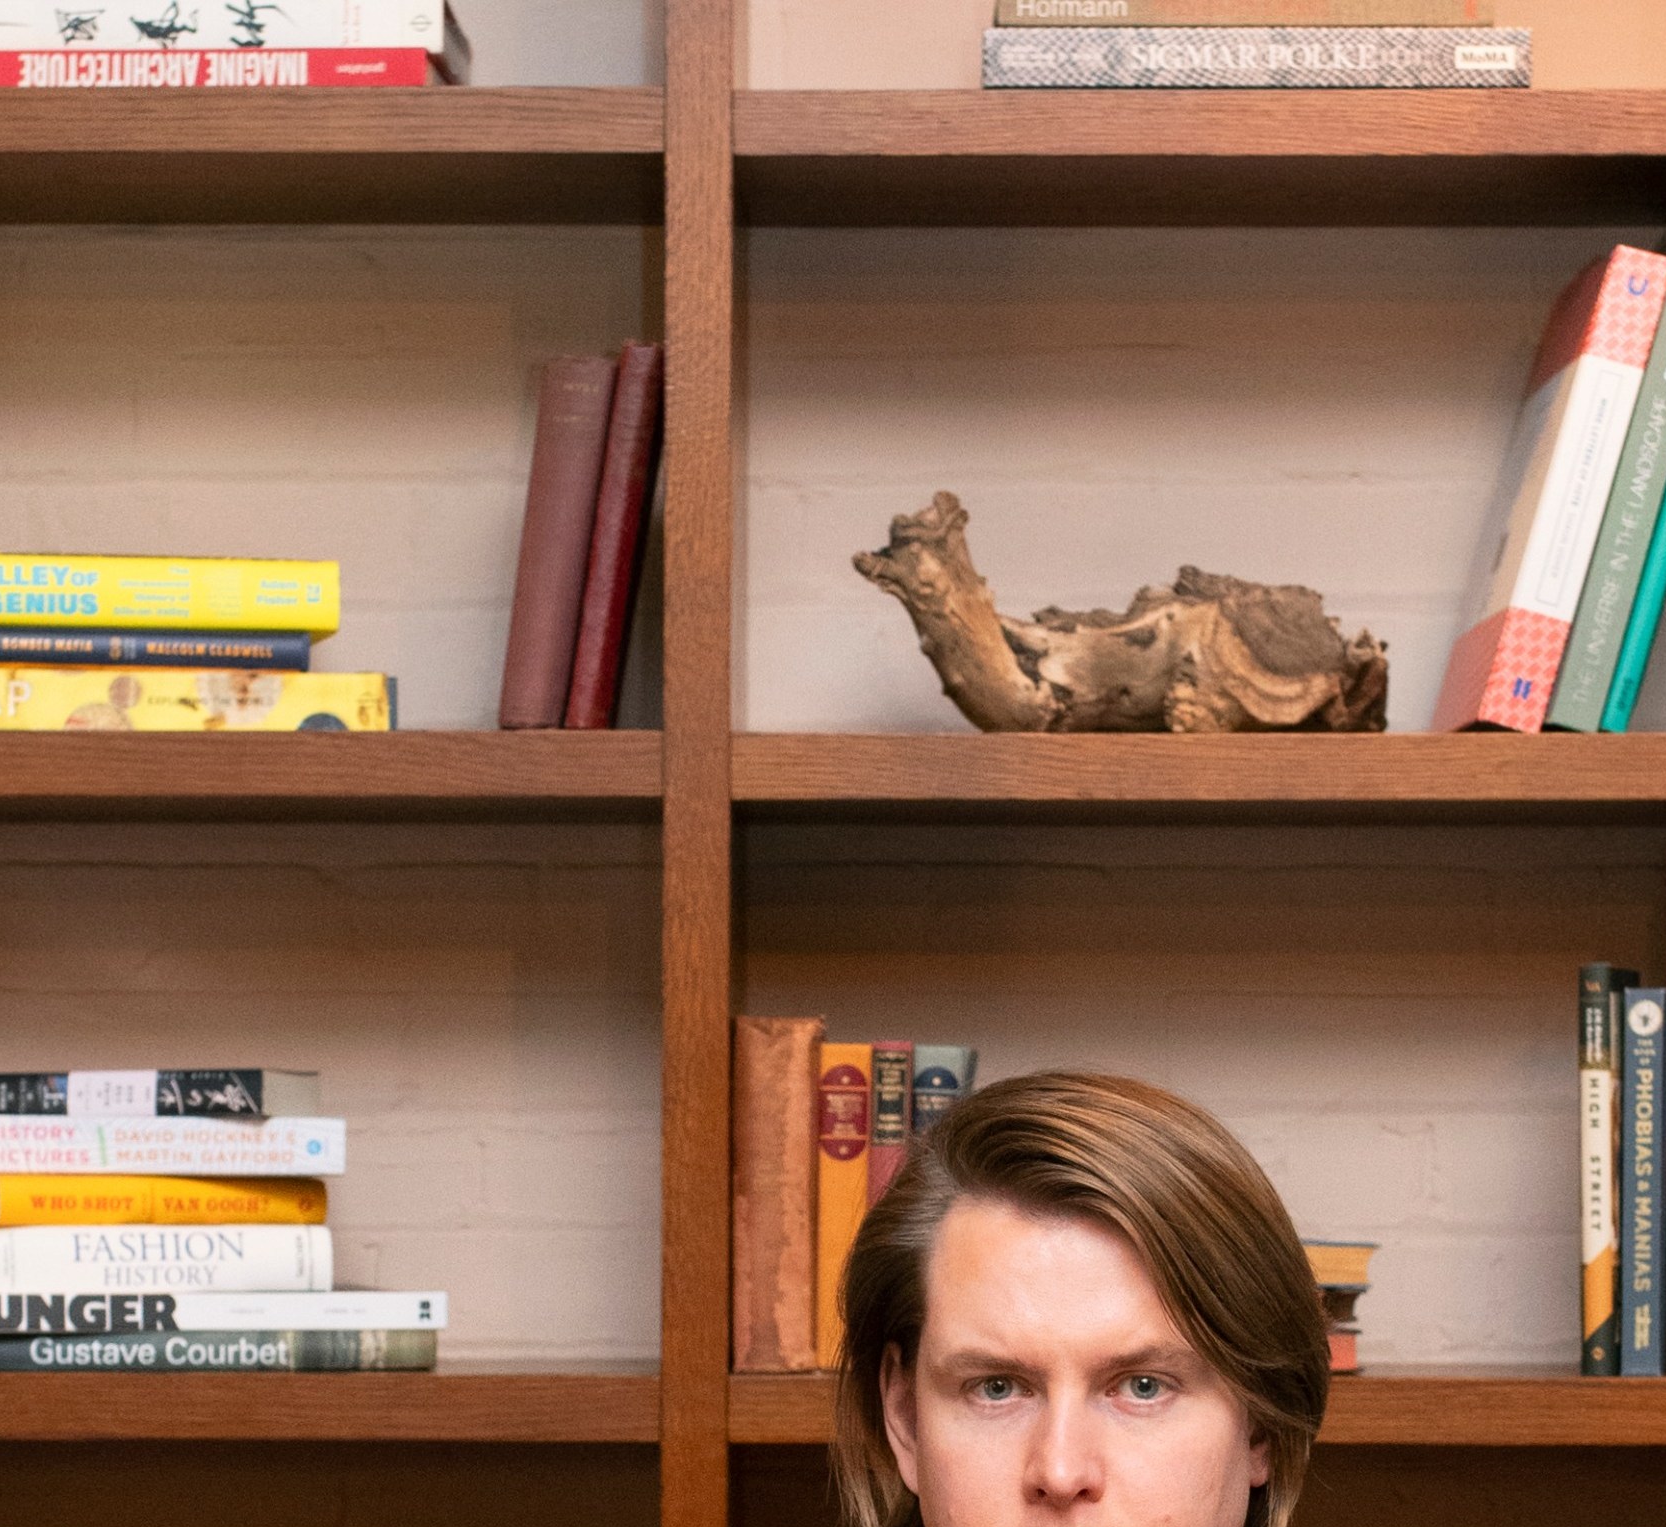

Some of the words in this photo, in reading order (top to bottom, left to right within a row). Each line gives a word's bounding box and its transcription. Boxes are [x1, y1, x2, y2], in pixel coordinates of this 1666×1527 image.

[19, 53, 201, 88] ARCHITECTURE
[206, 52, 308, 86] IMAGINE
[1135, 45, 1258, 69] SIGMAR
[1268, 45, 1377, 69] POLKE
[1462, 50, 1510, 64] MoMA
[1613, 509, 1639, 547] THE
[1606, 549, 1628, 571] IN
[71, 572, 99, 587] OF
[1580, 574, 1621, 665] UNIVERSE
[2, 636, 51, 652] BOMBER
[55, 637, 93, 652] MAFIA
[146, 642, 205, 657] MALCOLM
[209, 643, 273, 658] GLADWELL
[1569, 668, 1594, 705] THE
[1588, 1077, 1600, 1129] HIGH
[1636, 1067, 1653, 1176] PHOBIAS
[115, 1130, 174, 1146] DAVID
[183, 1129, 279, 1147] HOCKNEY
[116, 1149, 191, 1165] MARTIN
[200, 1149, 294, 1166] GAYFORD
[31, 1196, 79, 1212] WHO
[82, 1196, 134, 1212] SHOT
[163, 1196, 201, 1213] VAN
[205, 1196, 270, 1213] GOGH?
[1589, 1154, 1601, 1232] STREET
[73, 1232, 245, 1264] FASHION
[1634, 1197, 1651, 1292] MANIAS
[103, 1266, 218, 1288] HISTORY
[30, 1338, 156, 1368] Gustave
[166, 1337, 288, 1366] Courbet
